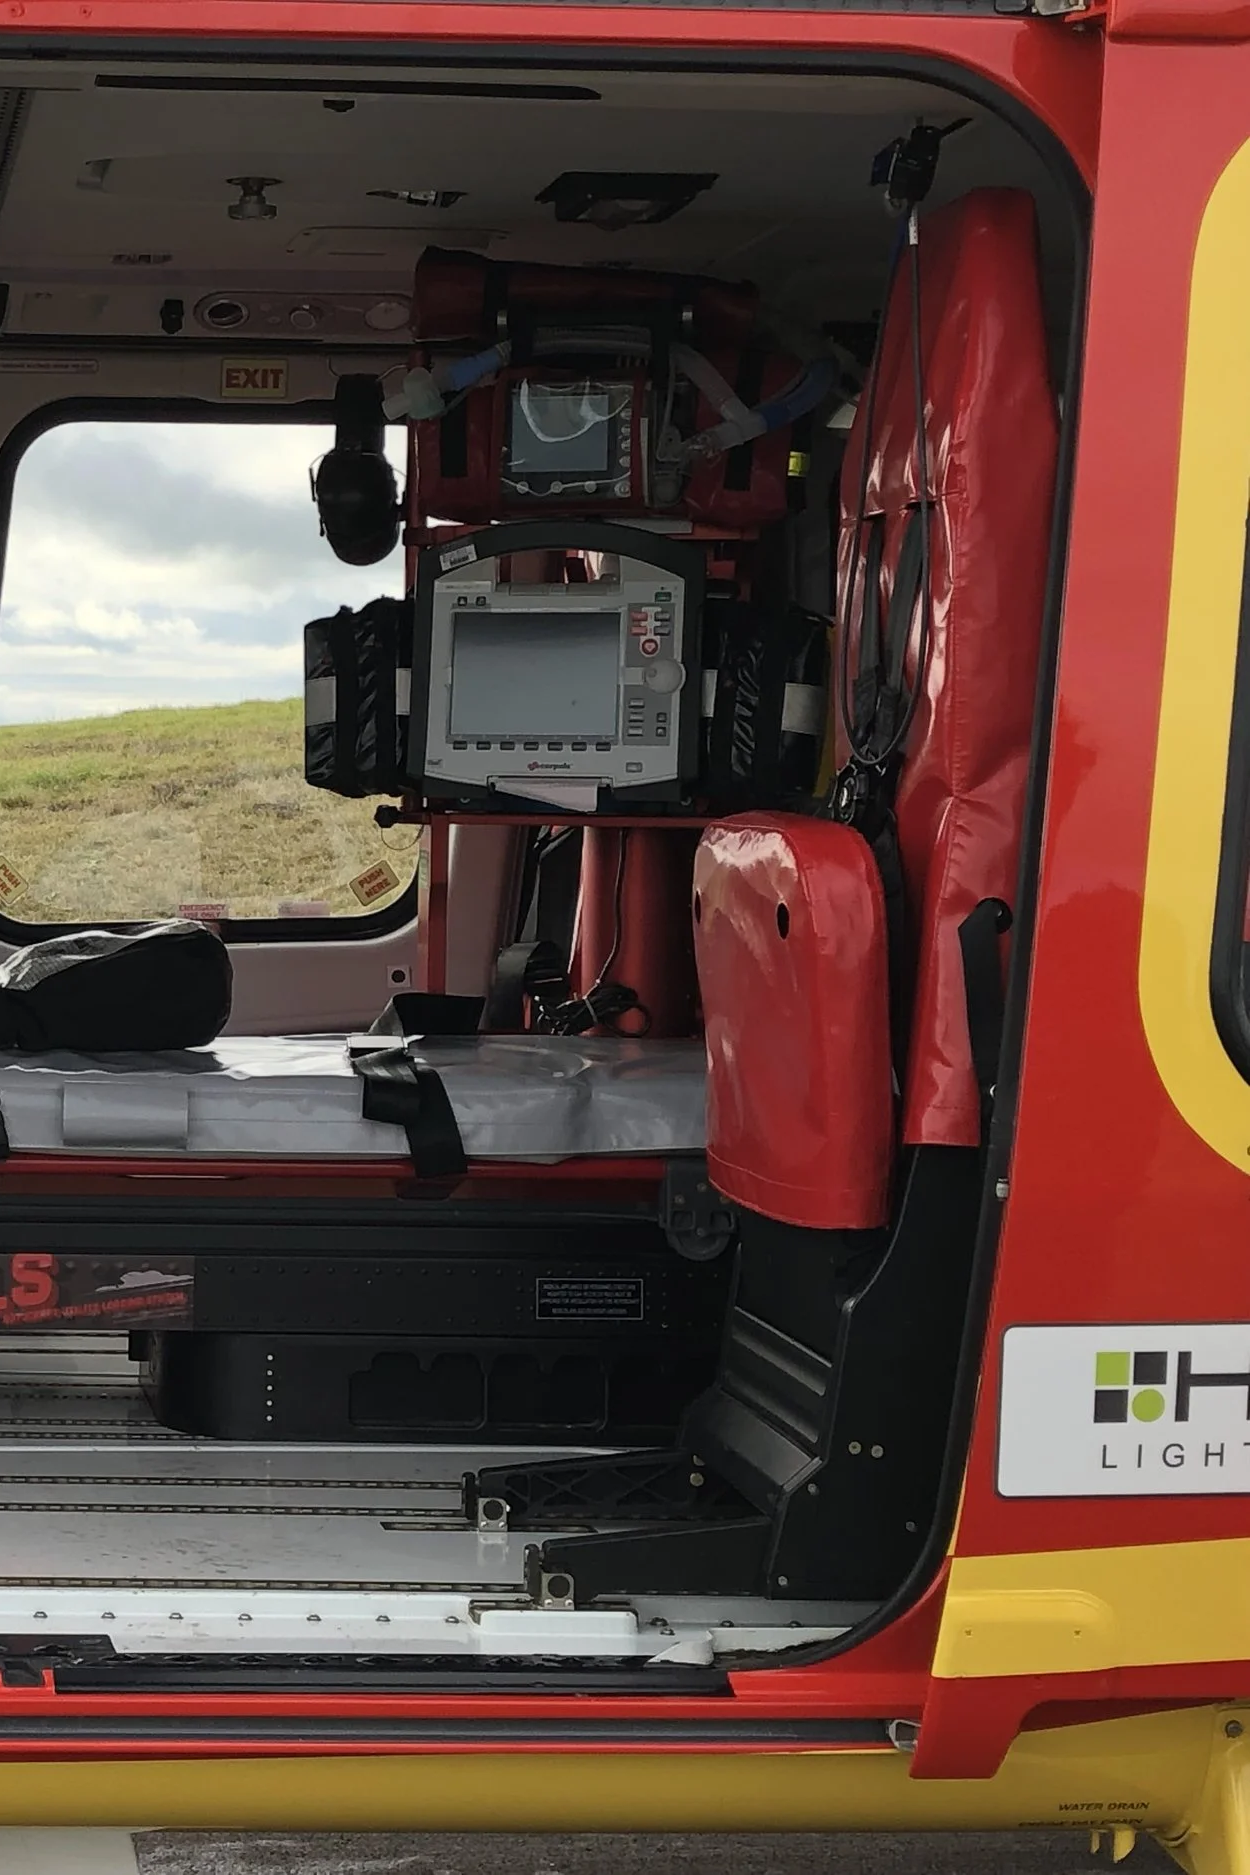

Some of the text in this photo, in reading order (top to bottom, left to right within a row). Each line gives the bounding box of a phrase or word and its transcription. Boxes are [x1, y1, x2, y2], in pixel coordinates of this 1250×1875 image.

[225, 367, 284, 389] EXIT
[358, 868, 384, 888] PUSH
[365, 878, 391, 898] HERE
[200, 911, 221, 920] ONLY
[1058, 1801, 1150, 1812] WATER DRAIN
